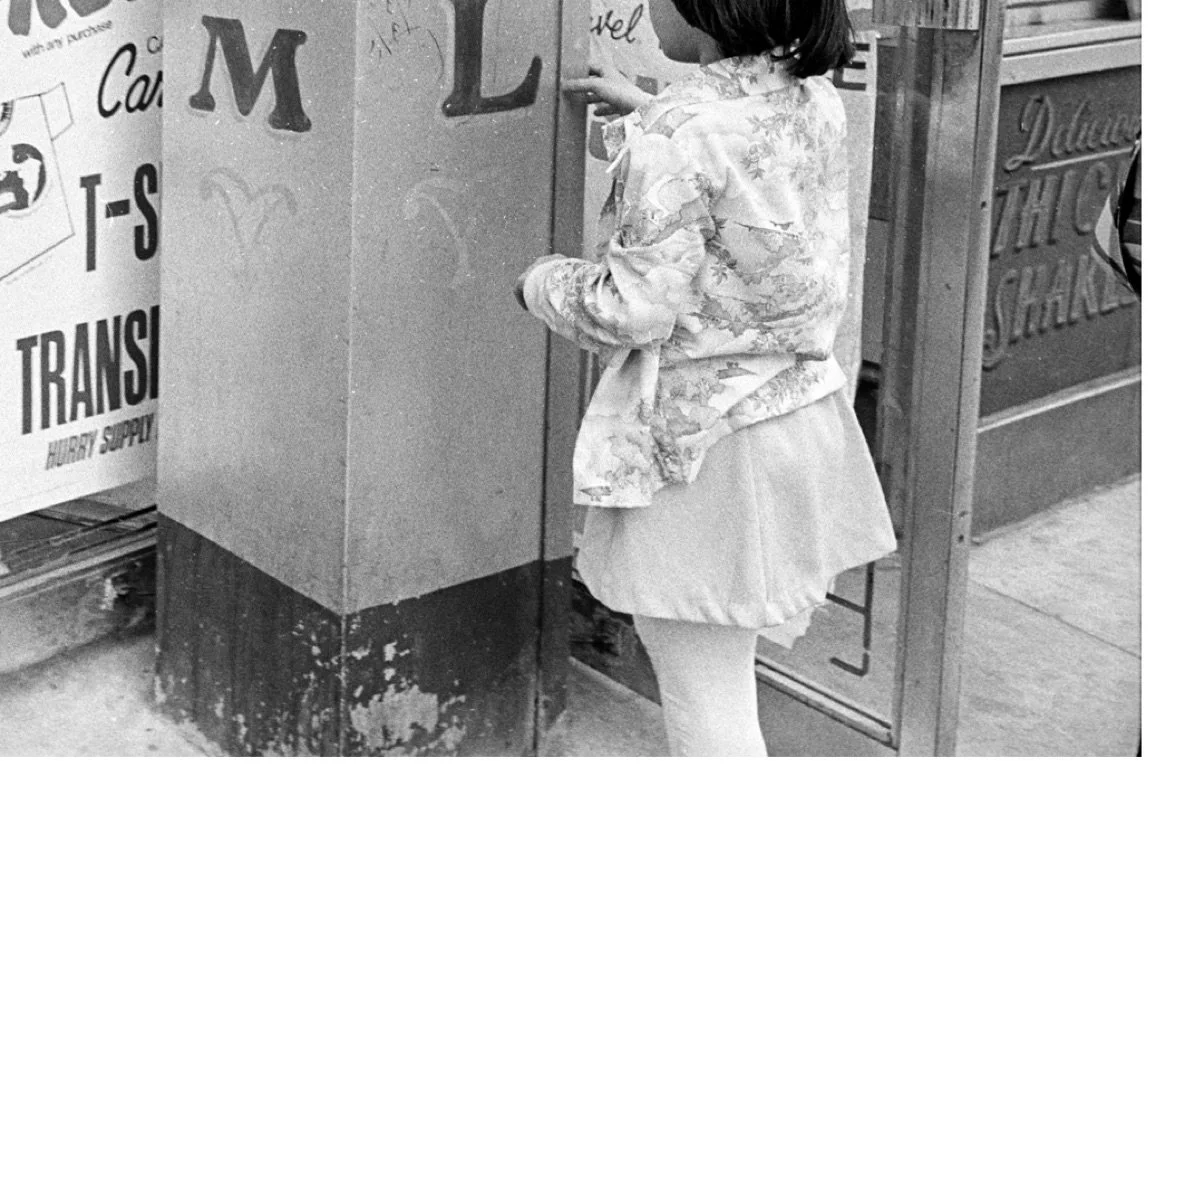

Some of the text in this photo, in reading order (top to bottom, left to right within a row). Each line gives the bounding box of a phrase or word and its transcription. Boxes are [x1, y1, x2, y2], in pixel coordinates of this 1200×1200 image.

[67, 19, 113, 47] purchase
[45, 412, 155, 471] HURRY SUPPLY
